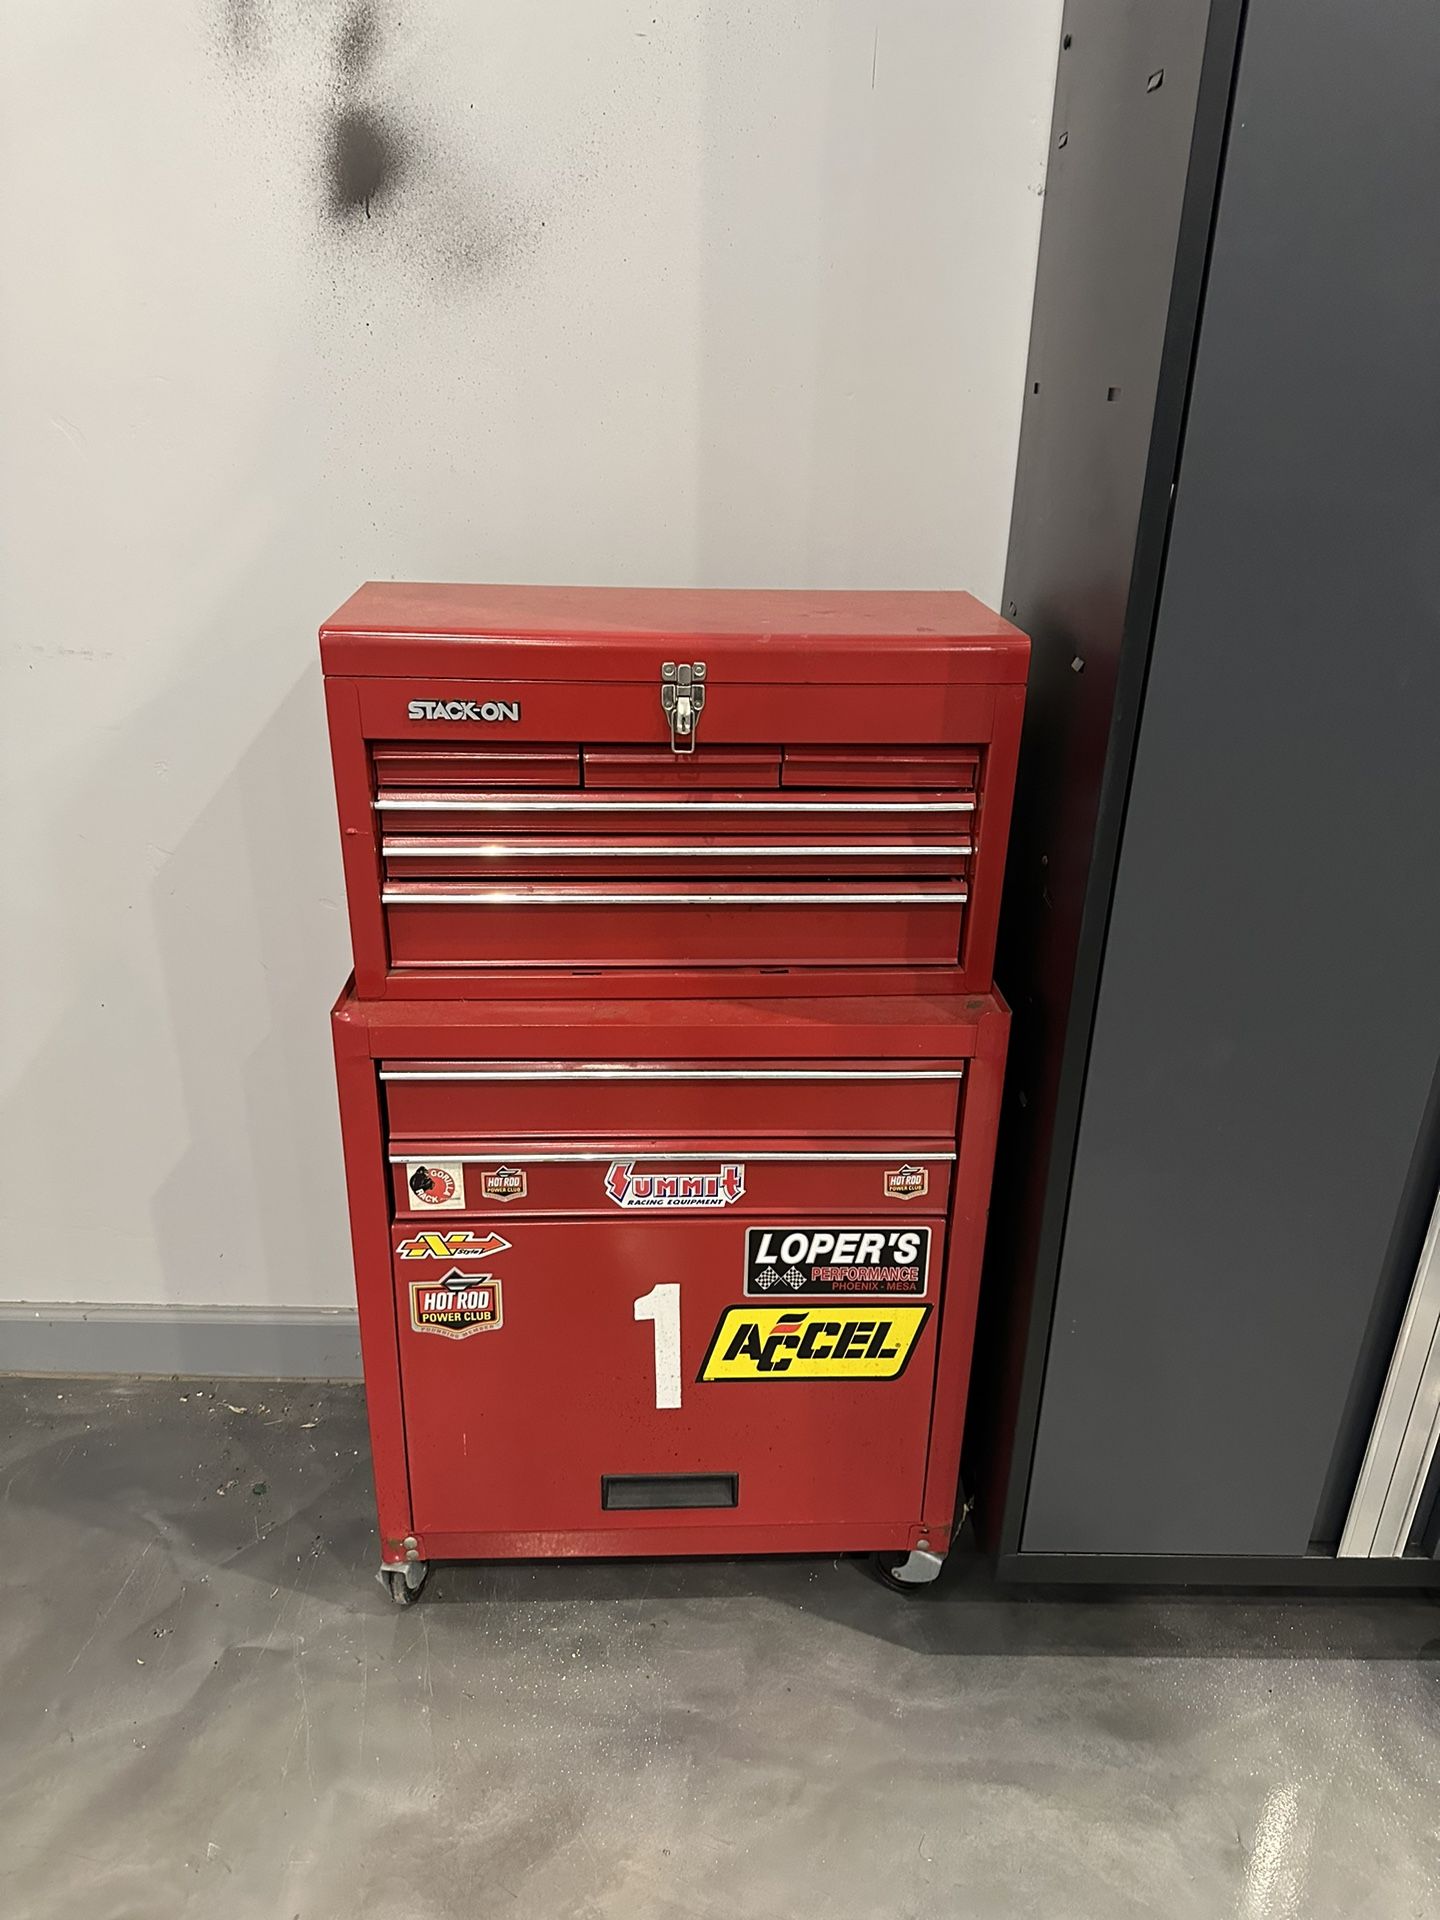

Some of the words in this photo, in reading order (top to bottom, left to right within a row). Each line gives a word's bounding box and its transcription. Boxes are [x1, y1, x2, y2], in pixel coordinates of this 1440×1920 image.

[407, 701, 519, 721] STACK-ON
[430, 1169, 454, 1197] GORILLA
[488, 1177, 503, 1187] HOT
[503, 1177, 520, 1187] ROD
[890, 1176, 905, 1185] HOT
[905, 1175, 921, 1185] ROD
[415, 1189, 439, 1204] RACK
[755, 1233, 921, 1265] LOPER'S
[811, 1267, 919, 1282] PERFORMANCE
[832, 1282, 878, 1291] PHOENIX
[886, 1282, 917, 1291] MESA
[424, 1292, 455, 1311] HOT
[456, 1291, 490, 1310] ROD
[422, 1312, 461, 1323] POWER
[463, 1311, 491, 1321] CLUB
[634, 1283, 681, 1409] 1
[722, 1322, 899, 1371] ACCEL
